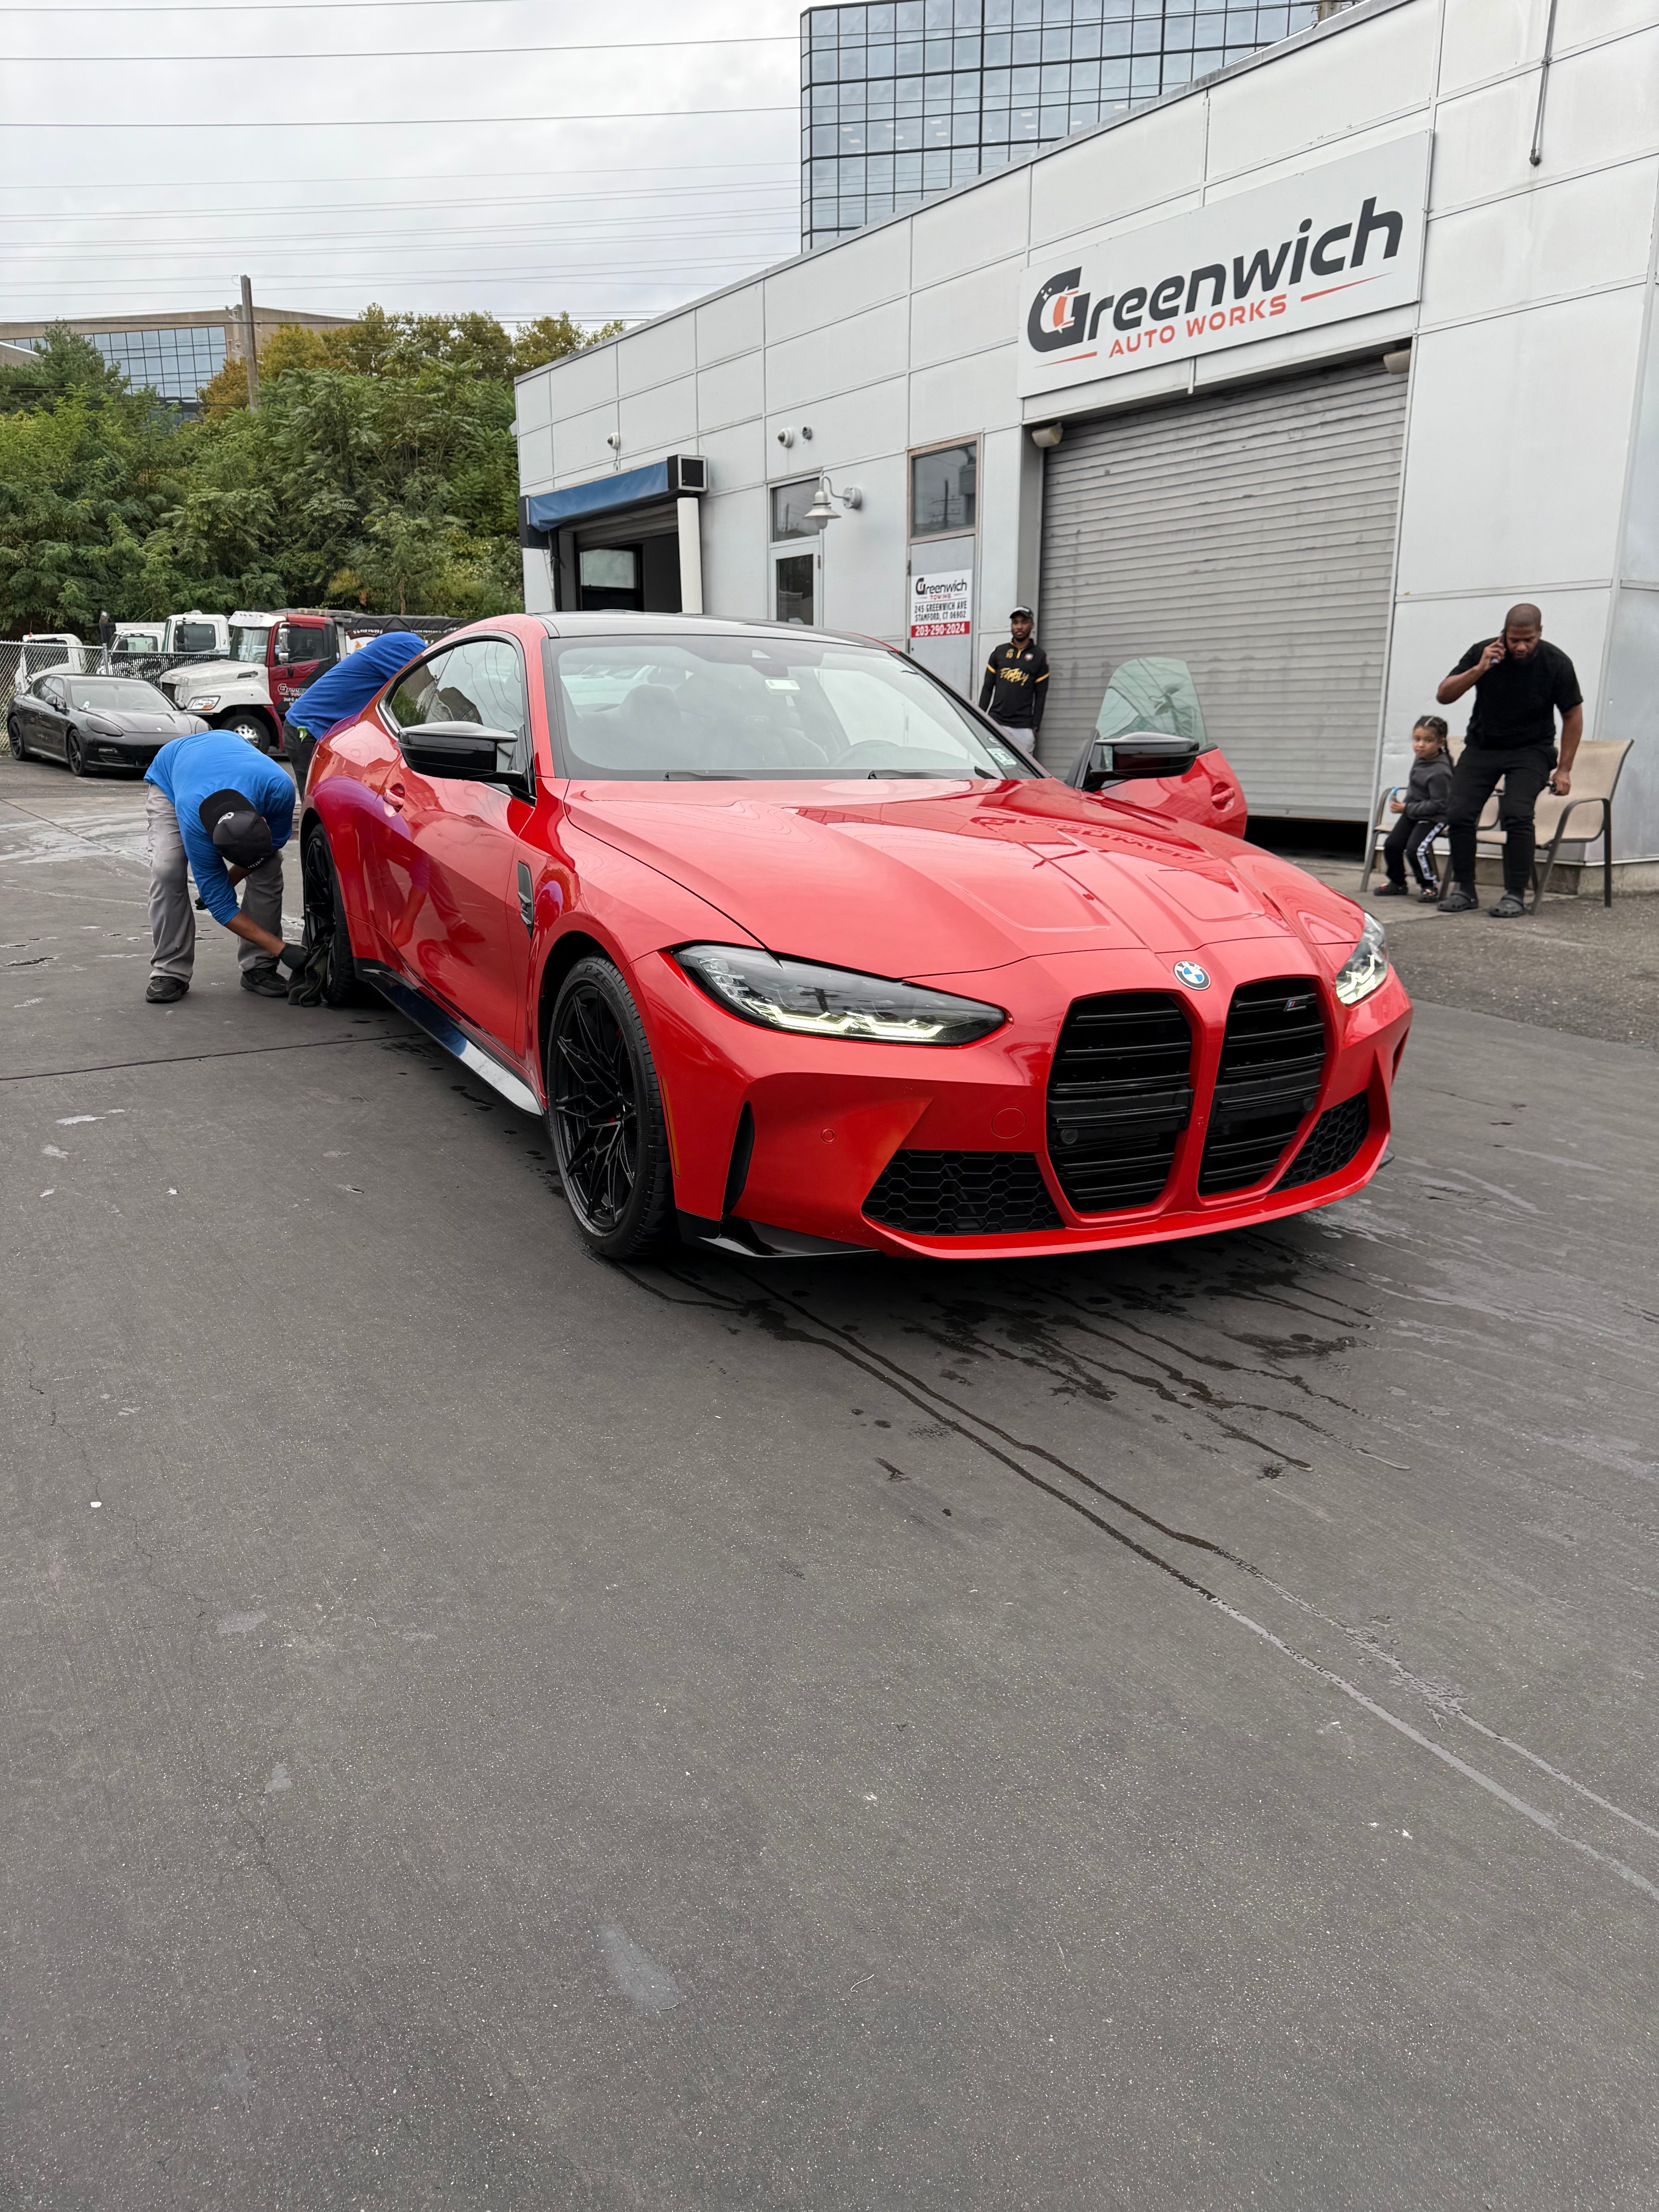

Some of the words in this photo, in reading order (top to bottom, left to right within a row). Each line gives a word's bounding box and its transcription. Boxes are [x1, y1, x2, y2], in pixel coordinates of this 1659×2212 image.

[1028, 196, 1403, 352] Greenwich
[1109, 325, 1175, 358] AUTO
[1186, 294, 1287, 338] WORKS
[915, 577, 967, 595] Greenwich
[915, 605, 924, 613] 245
[926, 601, 955, 612] GREENWICH
[942, 611, 949, 620] CT
[915, 623, 965, 636] 203-290-2024
